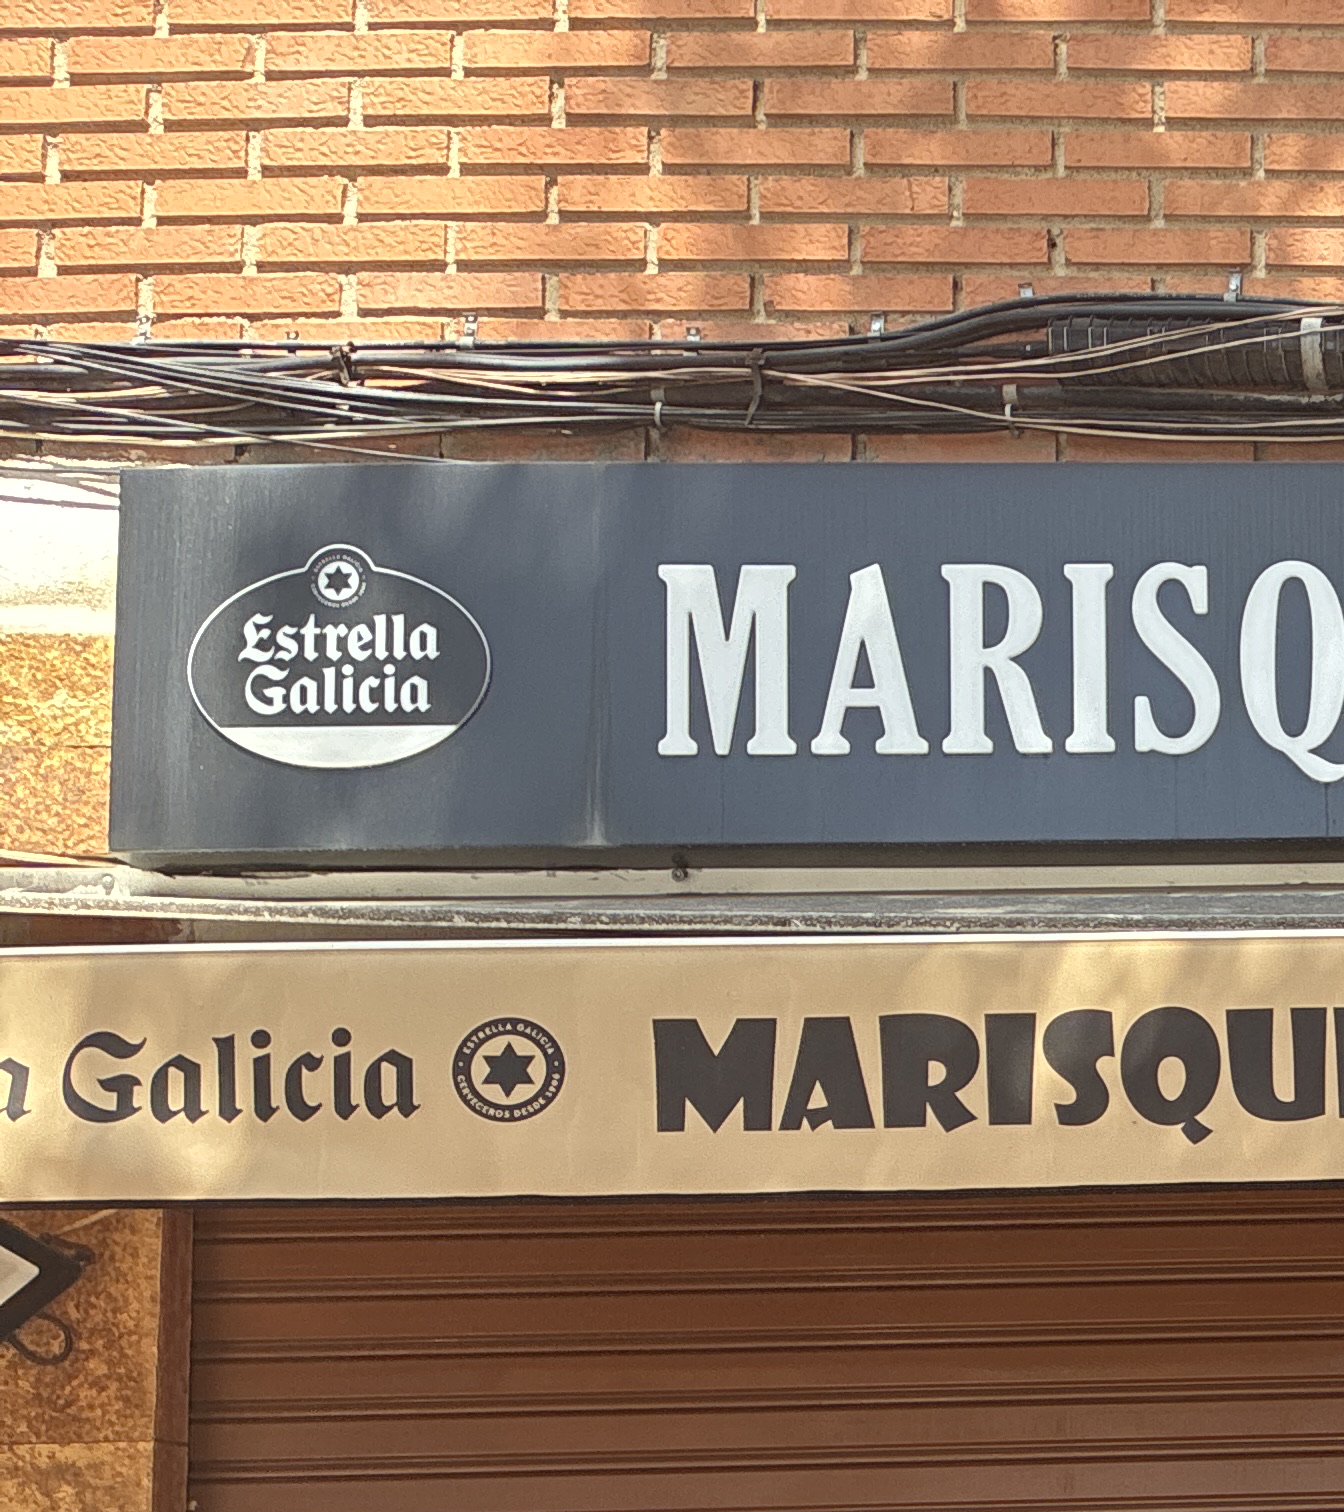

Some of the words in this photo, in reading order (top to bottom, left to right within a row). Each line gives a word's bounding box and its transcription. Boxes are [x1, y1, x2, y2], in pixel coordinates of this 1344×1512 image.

[238, 612, 441, 663] Estrella
[245, 663, 432, 716] Galicia
[462, 1022, 513, 1055] ESTRELLA
[516, 1022, 556, 1055] GALICIA
[62, 1026, 422, 1125] Galicia
[456, 1074, 511, 1119] CERVECEROS
[513, 1096, 547, 1118] DESDE
